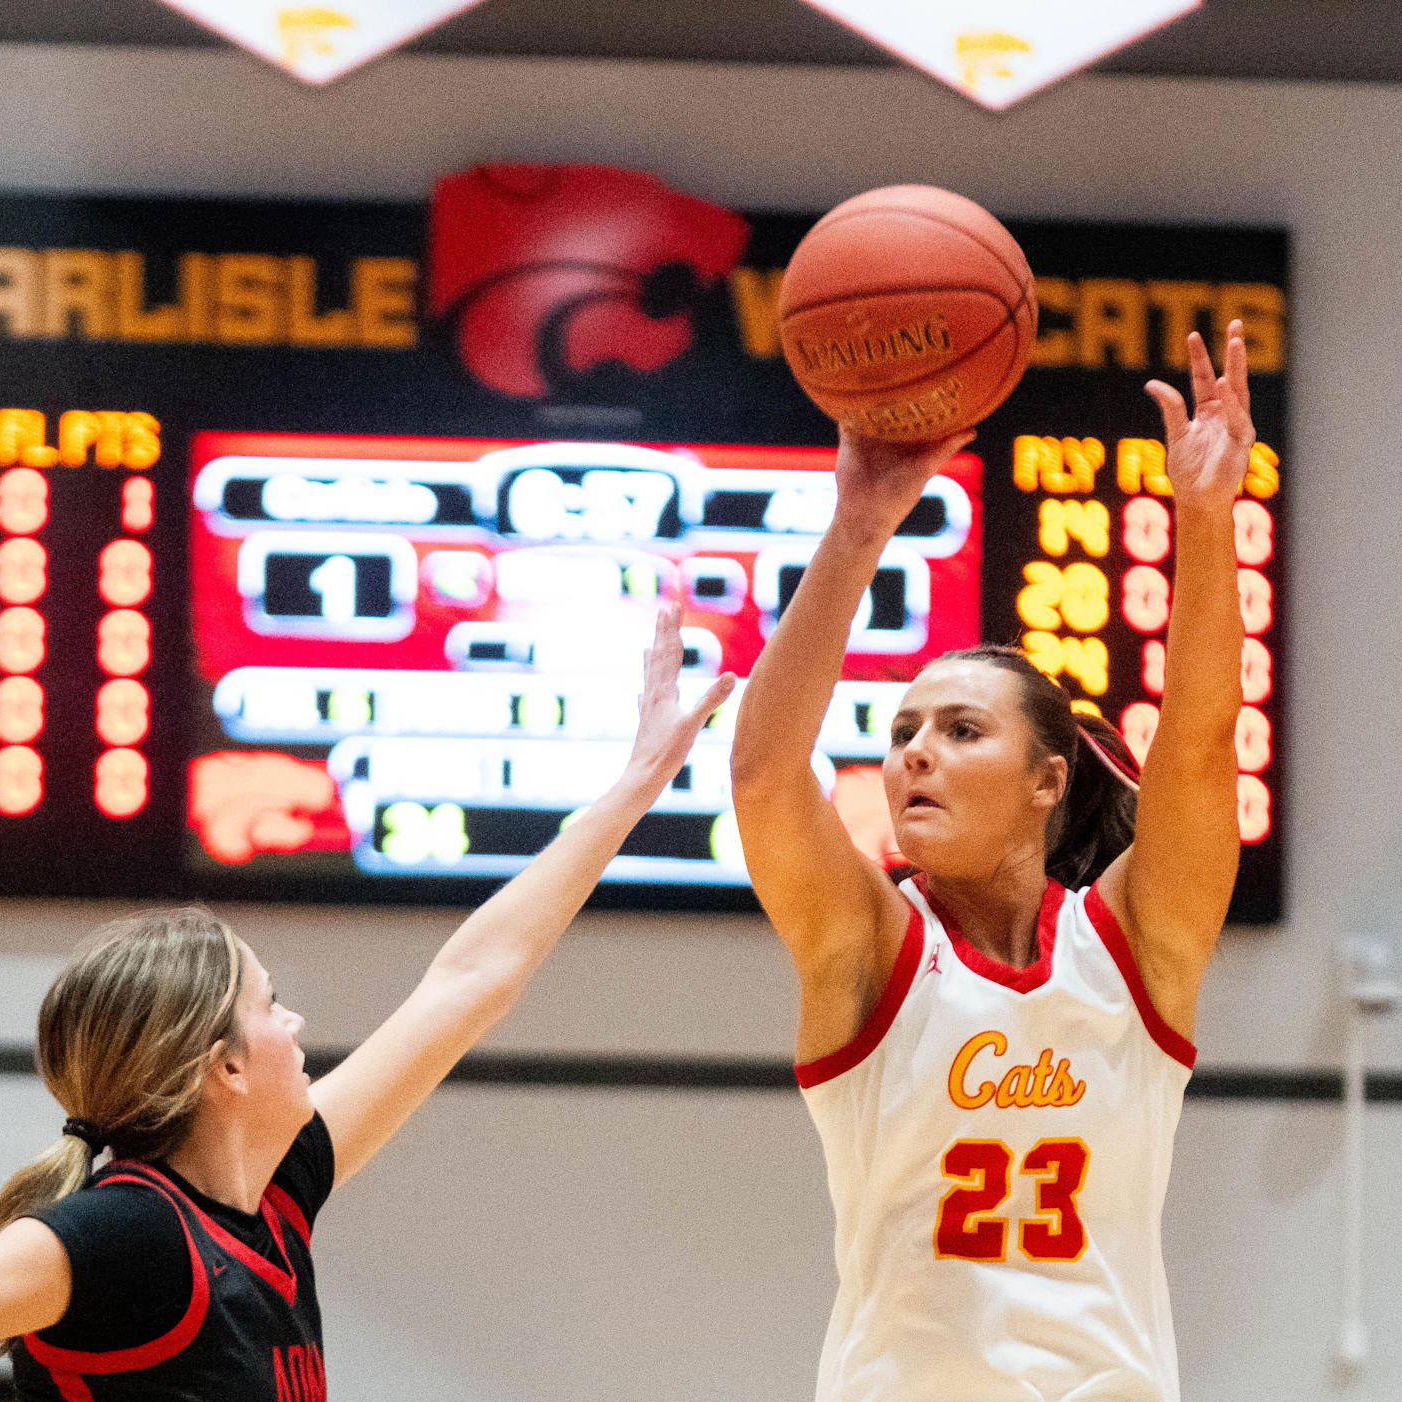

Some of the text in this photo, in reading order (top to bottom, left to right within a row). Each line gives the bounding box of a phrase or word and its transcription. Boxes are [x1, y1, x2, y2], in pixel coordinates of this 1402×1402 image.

[795, 313, 950, 373] SPALDING
[59, 410, 161, 469] PTS
[1121, 496, 1171, 563] 0
[310, 555, 356, 623] 1
[1121, 565, 1170, 634] 0
[948, 1030, 1086, 1111] Cats
[933, 1136, 1092, 1264] 23
